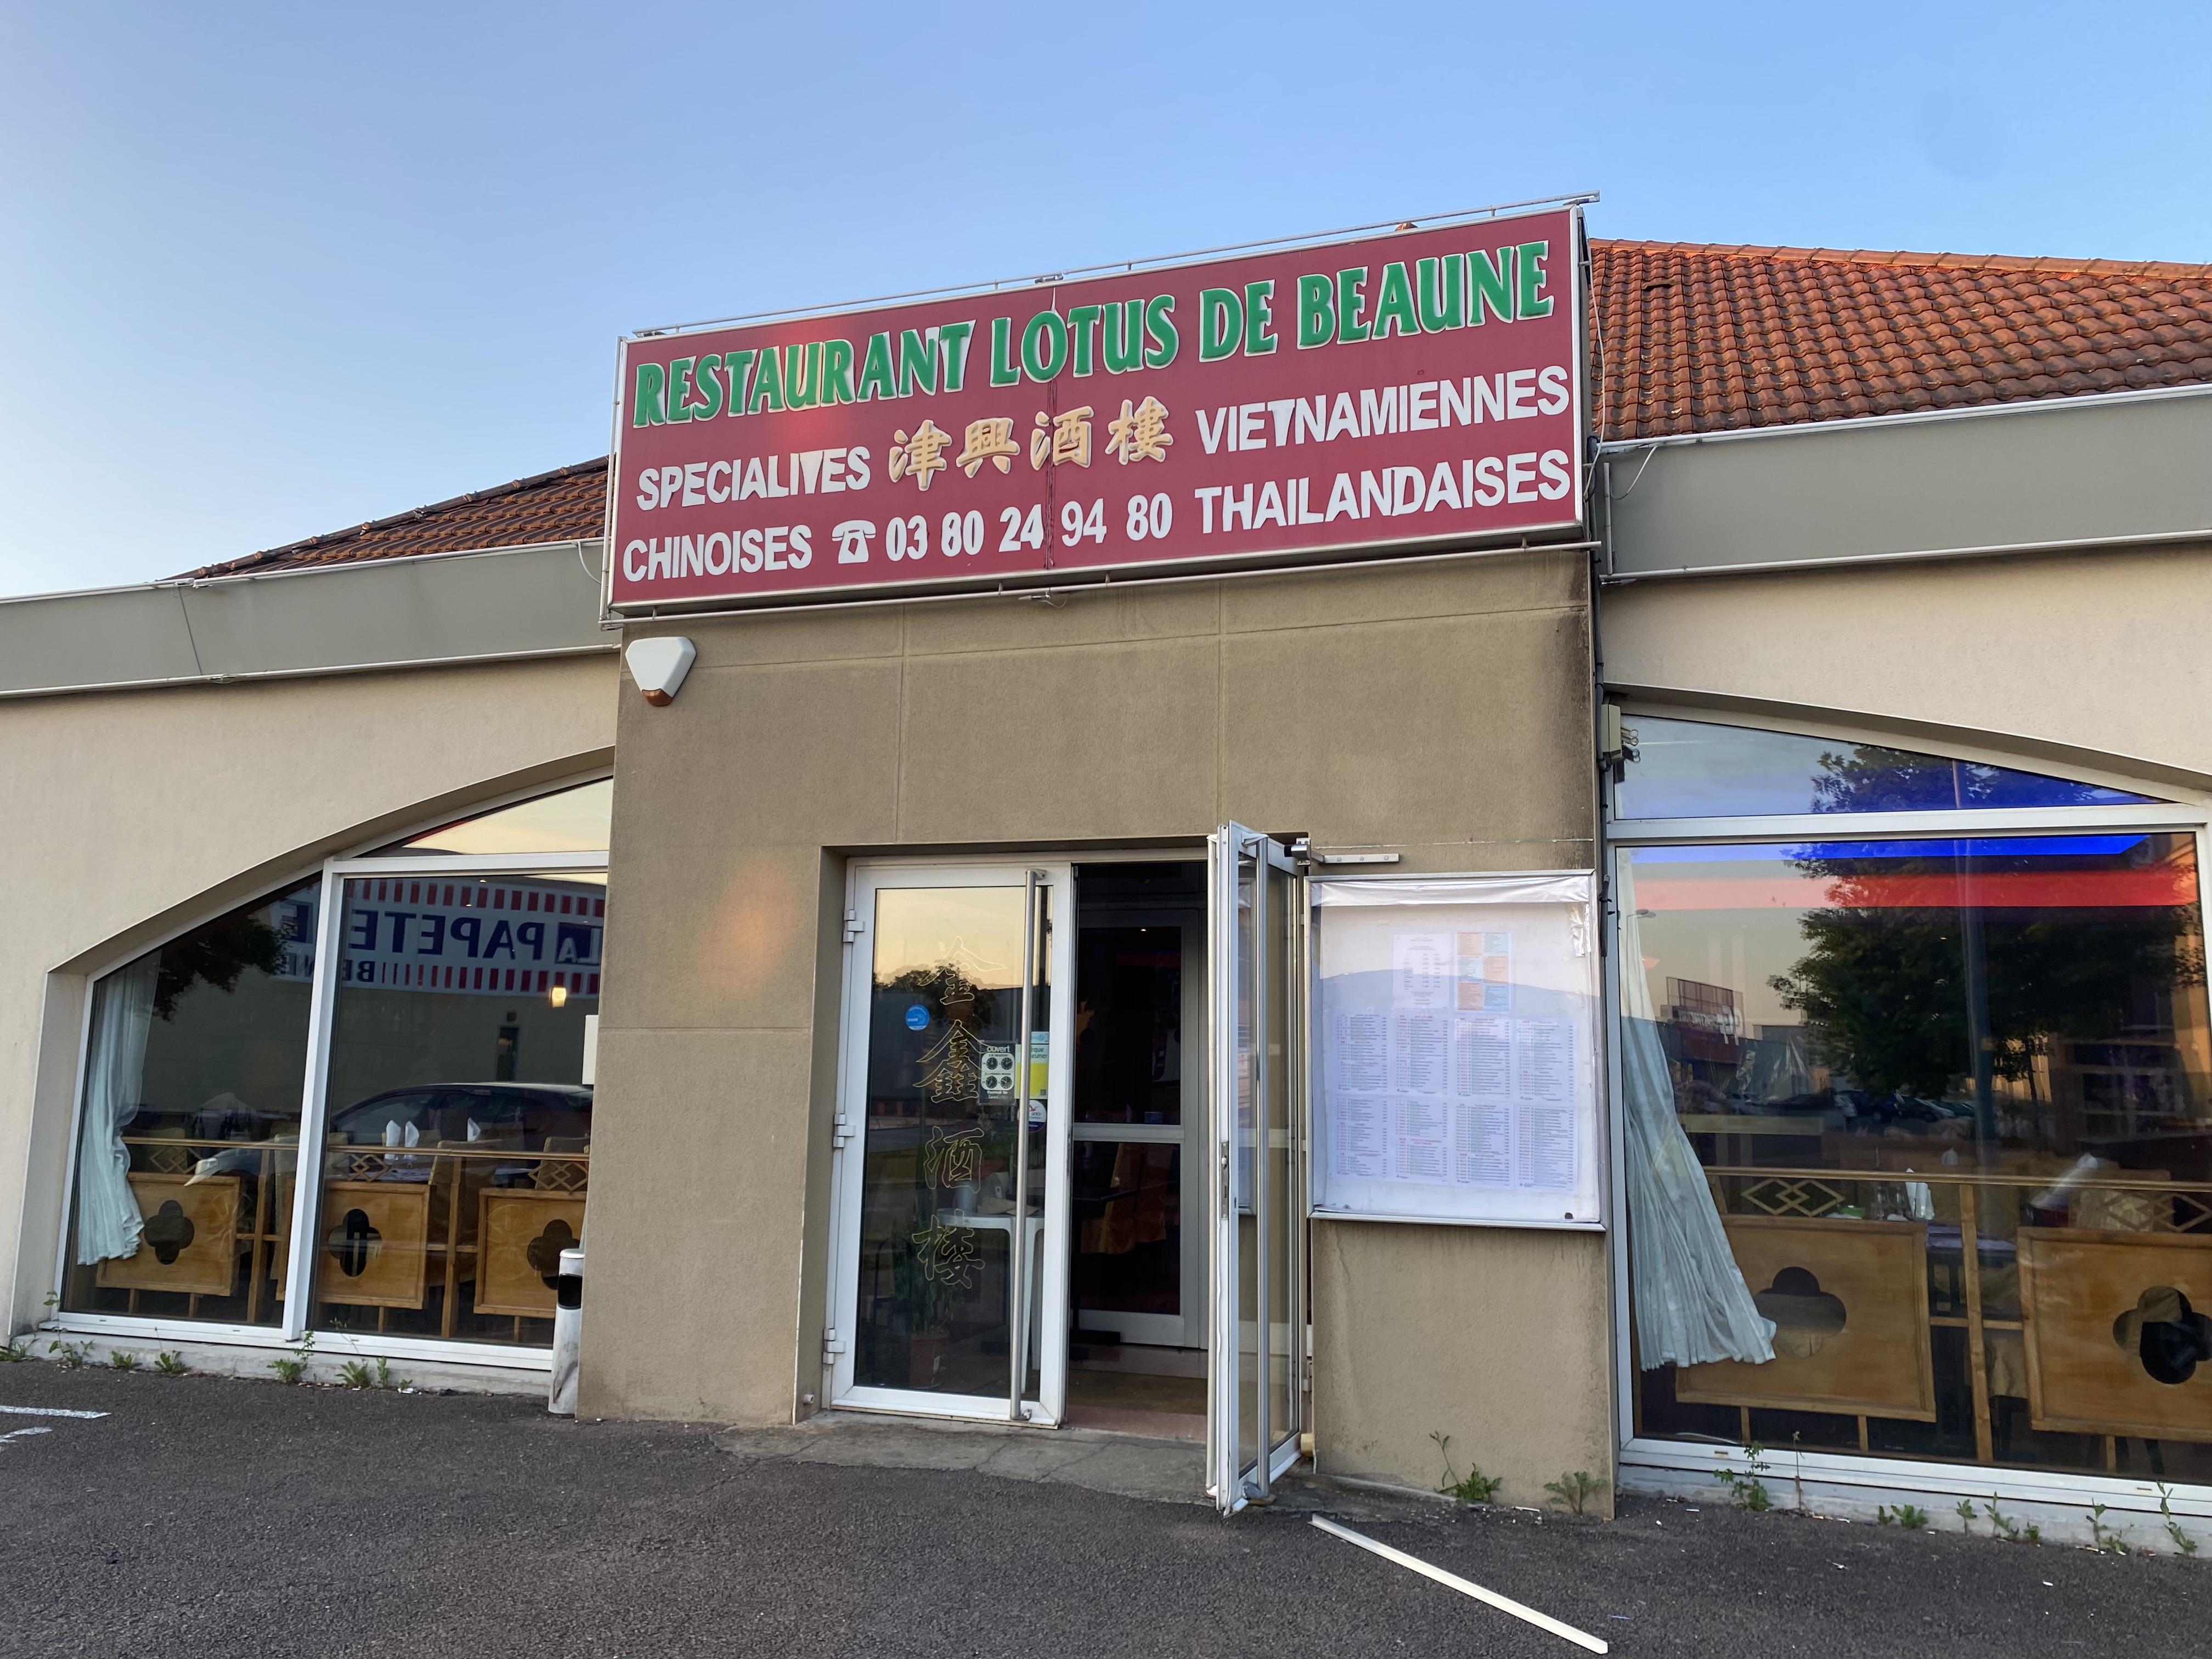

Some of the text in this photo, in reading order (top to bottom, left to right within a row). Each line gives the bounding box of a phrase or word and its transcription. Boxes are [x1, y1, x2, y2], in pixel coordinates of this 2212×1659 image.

[633, 240, 1555, 428] RESTAURANT LOTUS DE BEAUNE
[888, 396, 1173, 492] 津興酒樓
[1195, 365, 1570, 454] VIETNAMIENNES
[636, 446, 871, 511] SPECIALITES
[1194, 449, 1571, 534] THAILANDAISES
[623, 524, 812, 582] CHINOISES
[886, 493, 1172, 562] 03 80 24 94 80
